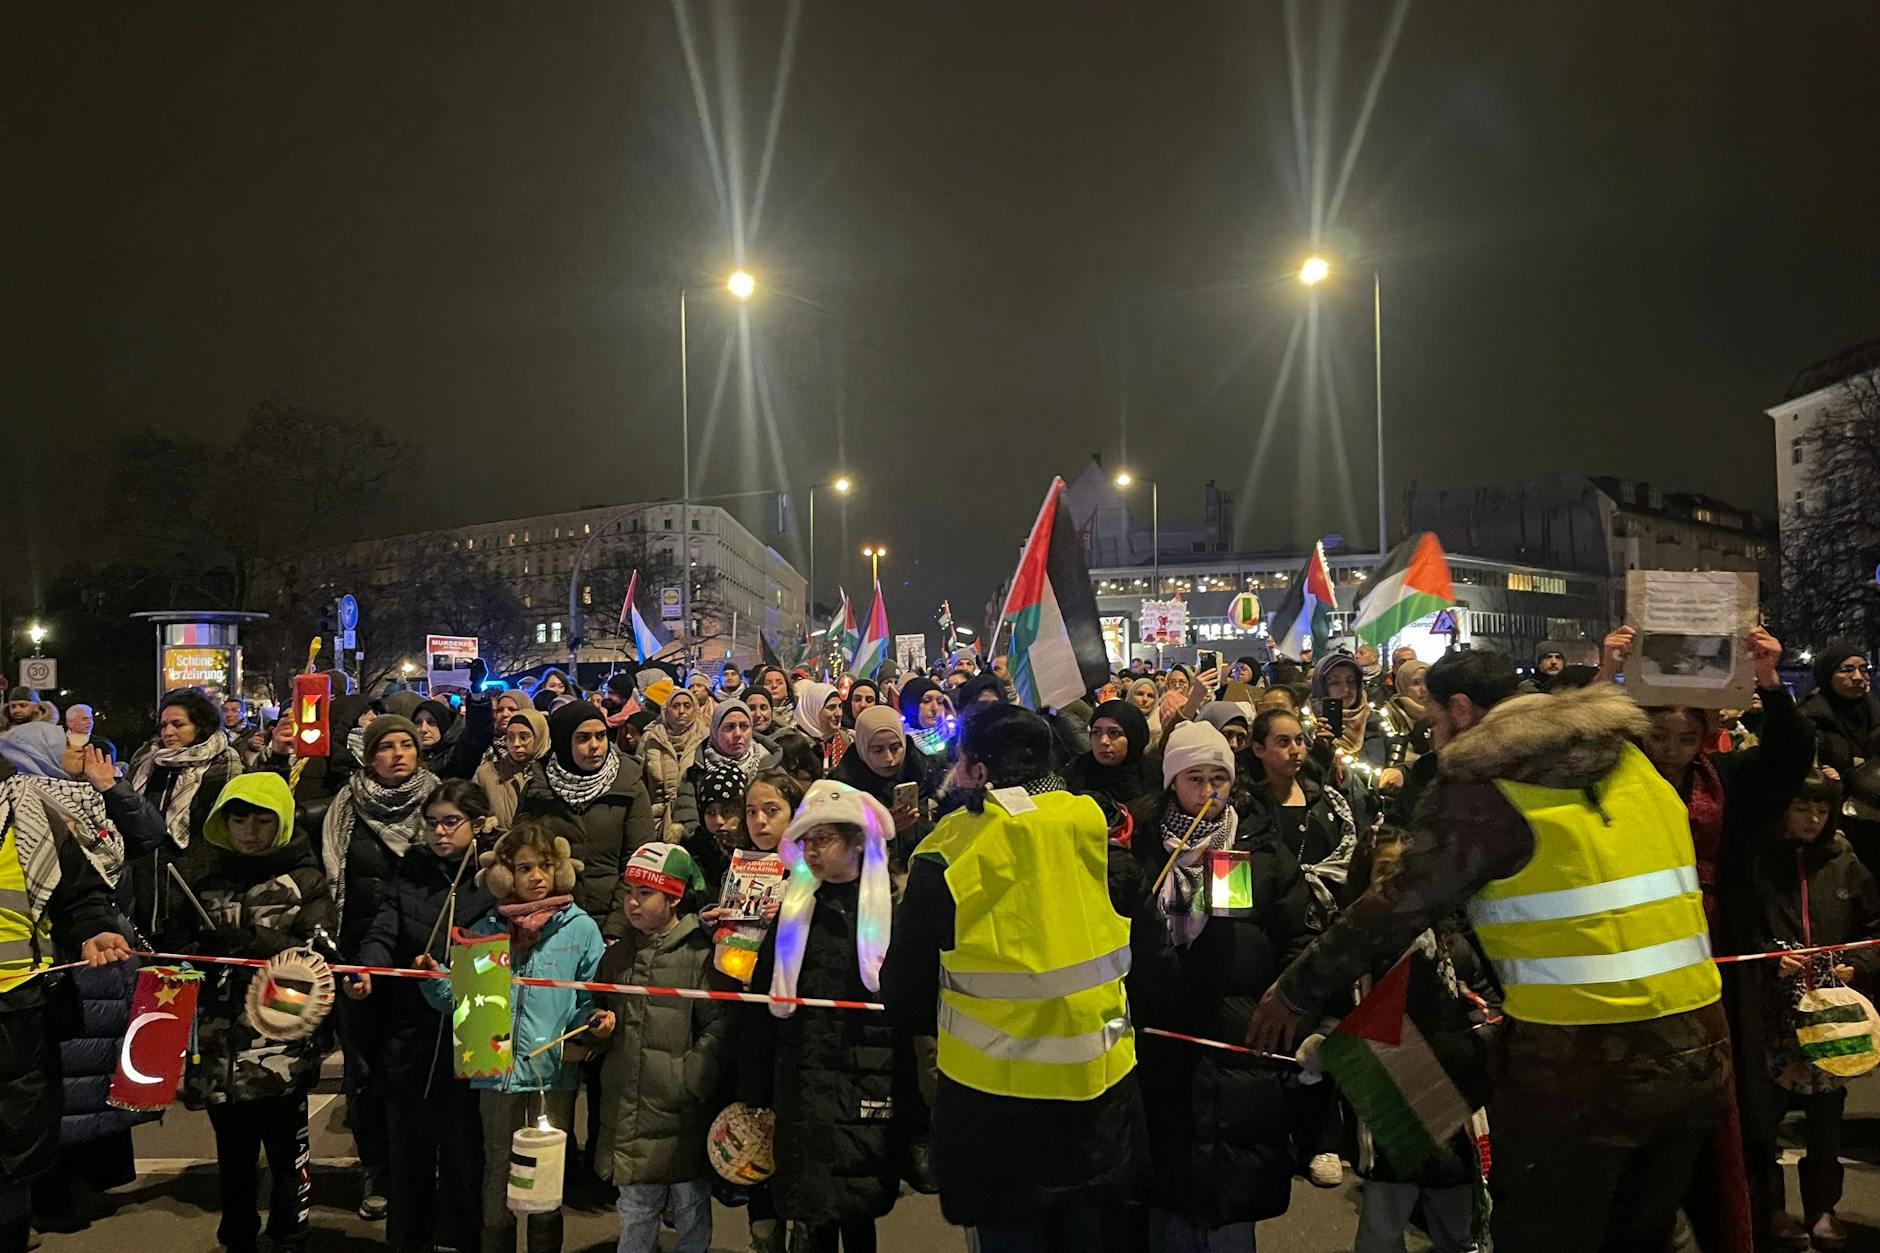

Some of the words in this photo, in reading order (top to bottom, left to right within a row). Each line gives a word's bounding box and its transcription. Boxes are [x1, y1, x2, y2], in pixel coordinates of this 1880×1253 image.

[176, 655, 214, 666] Schöne
[31, 666, 45, 677] 30
[168, 667, 224, 683] Verzehrung
